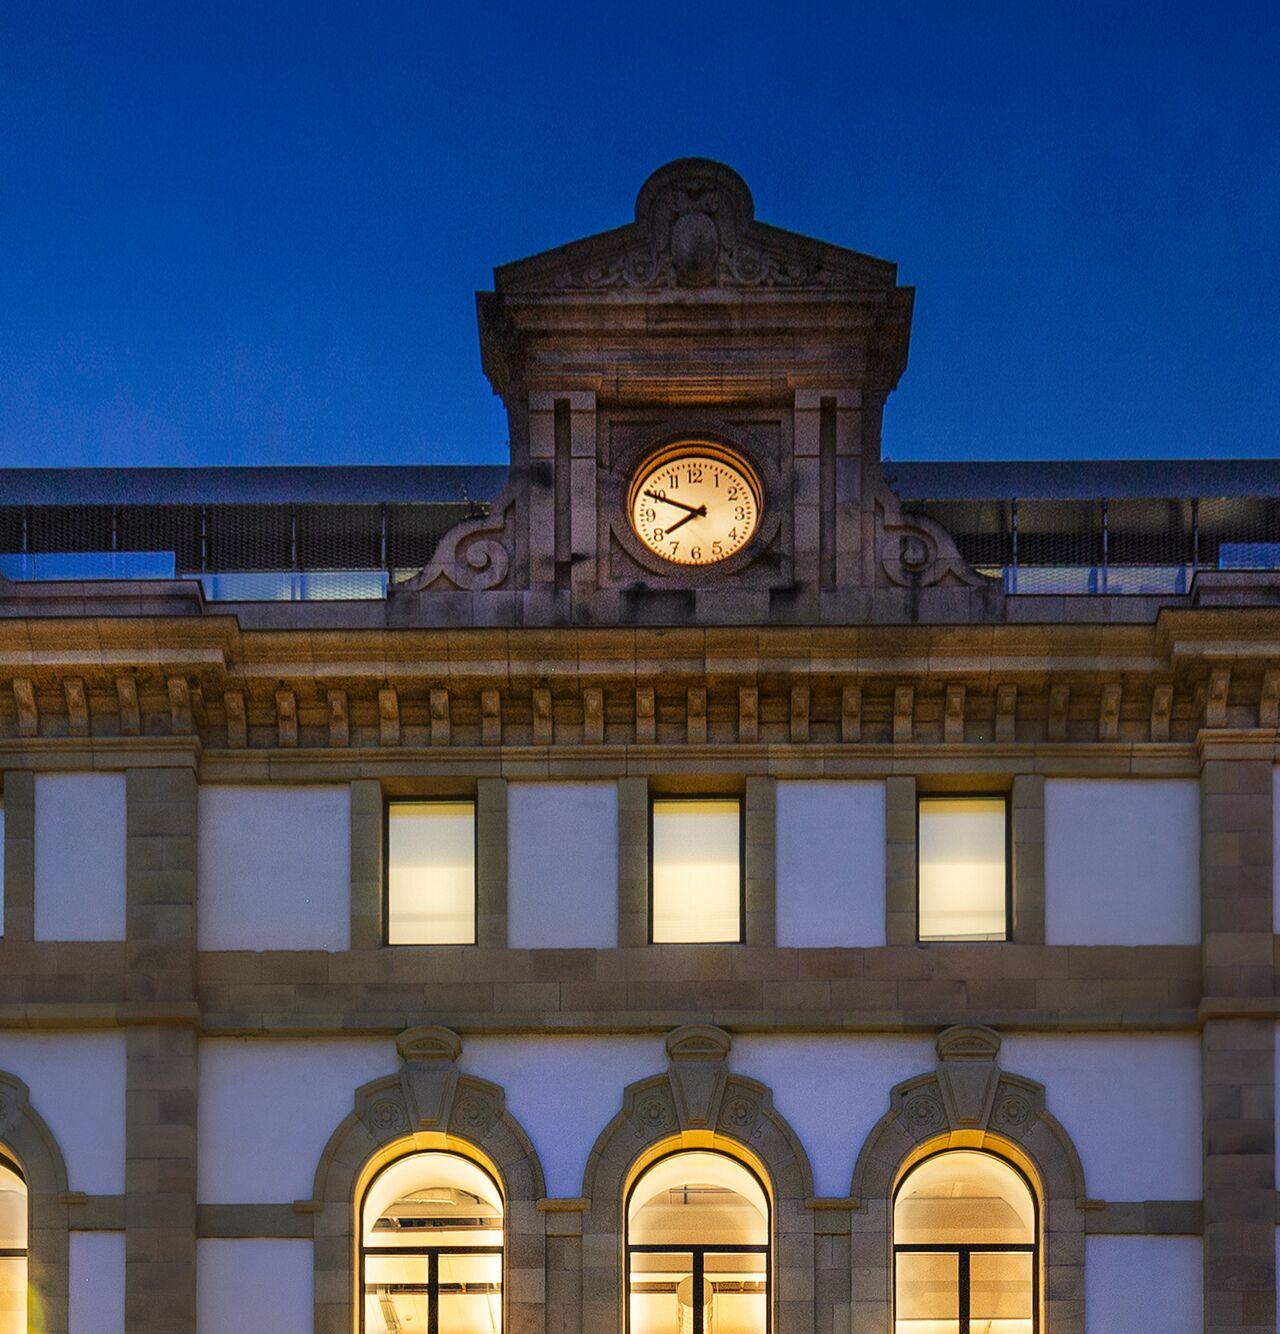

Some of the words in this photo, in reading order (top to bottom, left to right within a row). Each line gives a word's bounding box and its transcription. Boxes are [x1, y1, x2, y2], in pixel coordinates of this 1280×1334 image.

[669, 475, 679, 489] 11
[687, 469, 703, 483] 12
[714, 473, 719, 488] 1
[652, 489, 666, 503] 10
[728, 486, 738, 501] 2
[645, 508, 656, 522] 9
[734, 506, 745, 521] 3
[653, 528, 664, 541] 8
[728, 527, 737, 540] 4
[669, 541, 679, 555] 7
[691, 546, 701, 559] 6
[712, 541, 722, 554] 5
